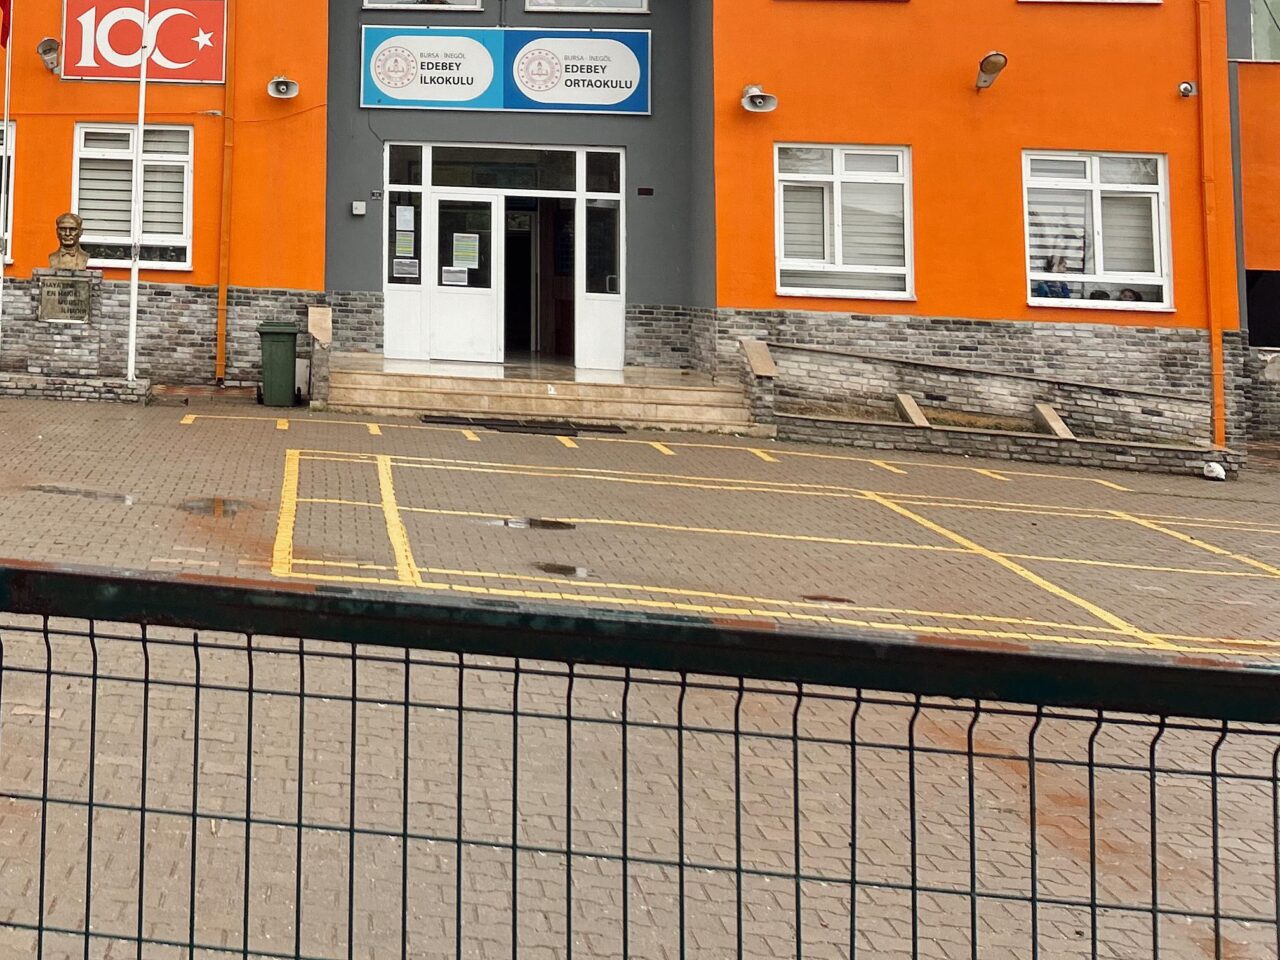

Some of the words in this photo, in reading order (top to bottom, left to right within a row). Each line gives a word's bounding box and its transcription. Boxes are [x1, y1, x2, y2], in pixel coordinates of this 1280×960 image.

[420, 61, 462, 71] EDEBEY
[564, 64, 607, 74] EDEBEY
[420, 73, 474, 86] İLKOKULU
[564, 78, 633, 89] ORTAOKULU
